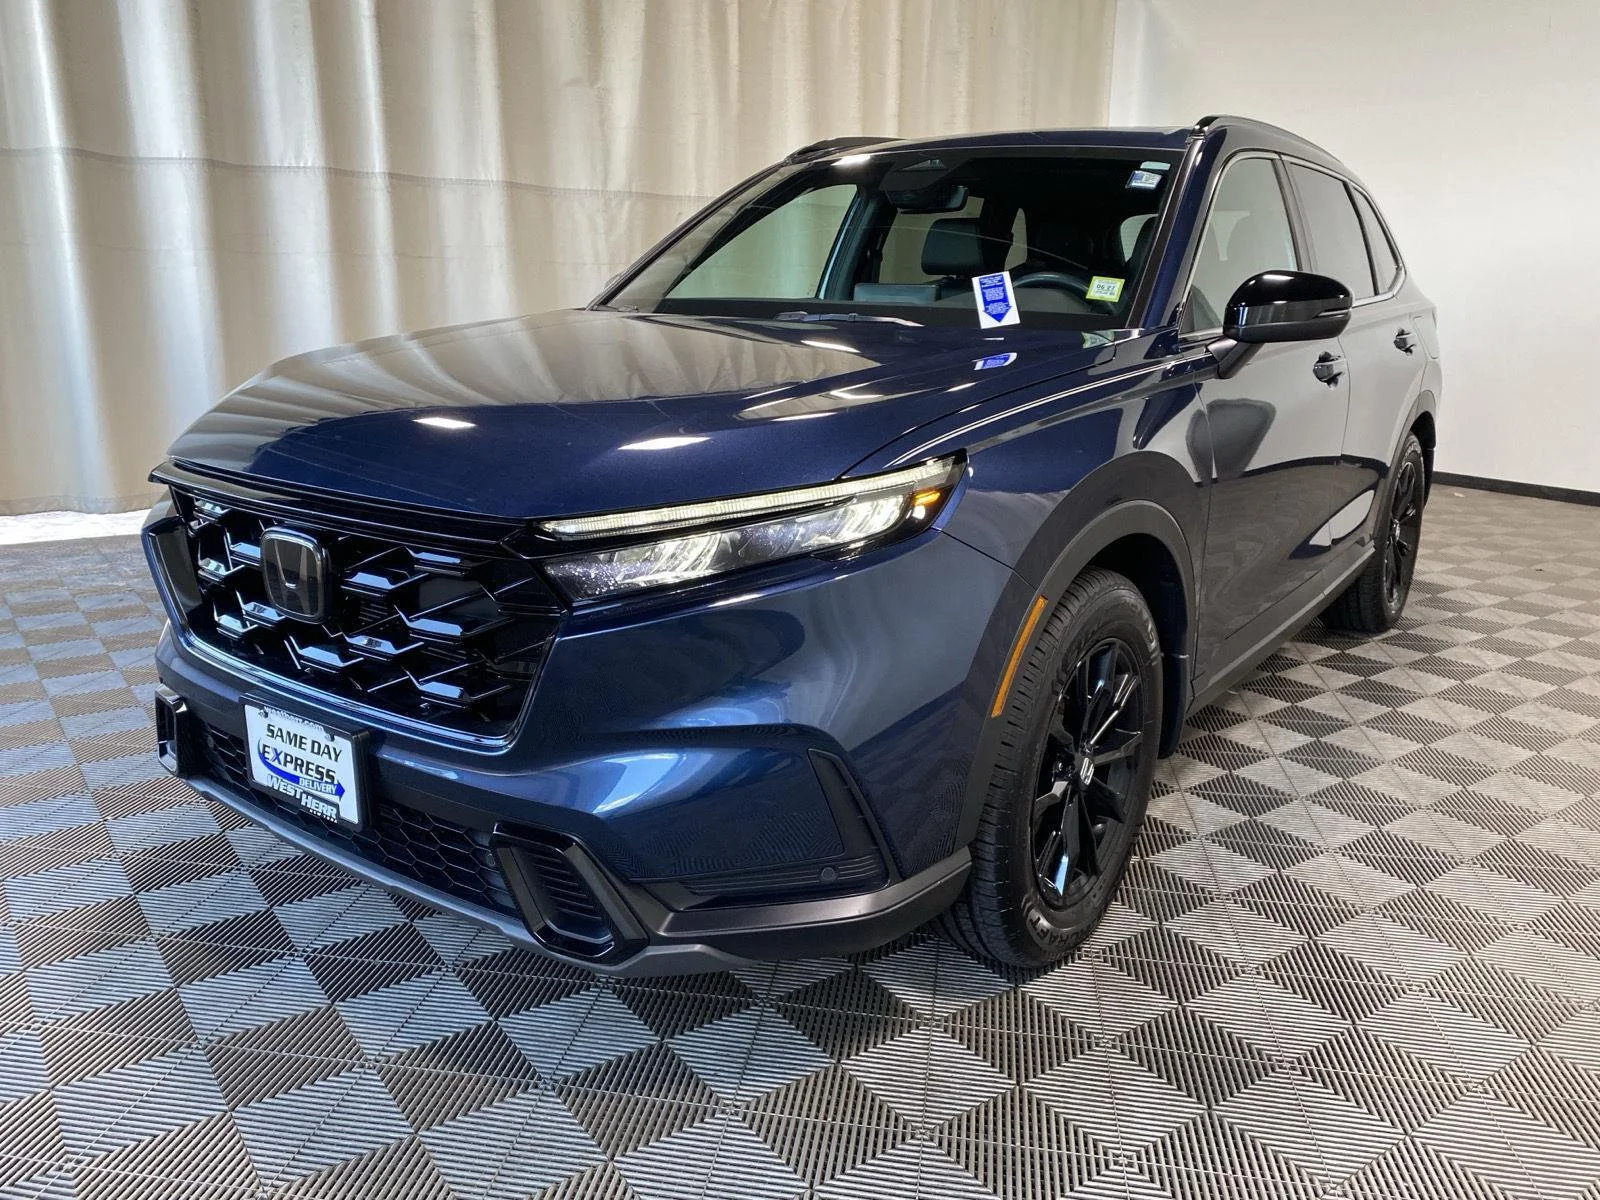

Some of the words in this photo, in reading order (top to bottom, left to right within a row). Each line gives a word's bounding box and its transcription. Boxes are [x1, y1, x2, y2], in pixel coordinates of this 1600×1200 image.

[266, 723, 308, 751] SAME
[310, 739, 342, 763] DAY
[262, 743, 336, 784] EXPRESS
[299, 777, 337, 795] DELIVERY
